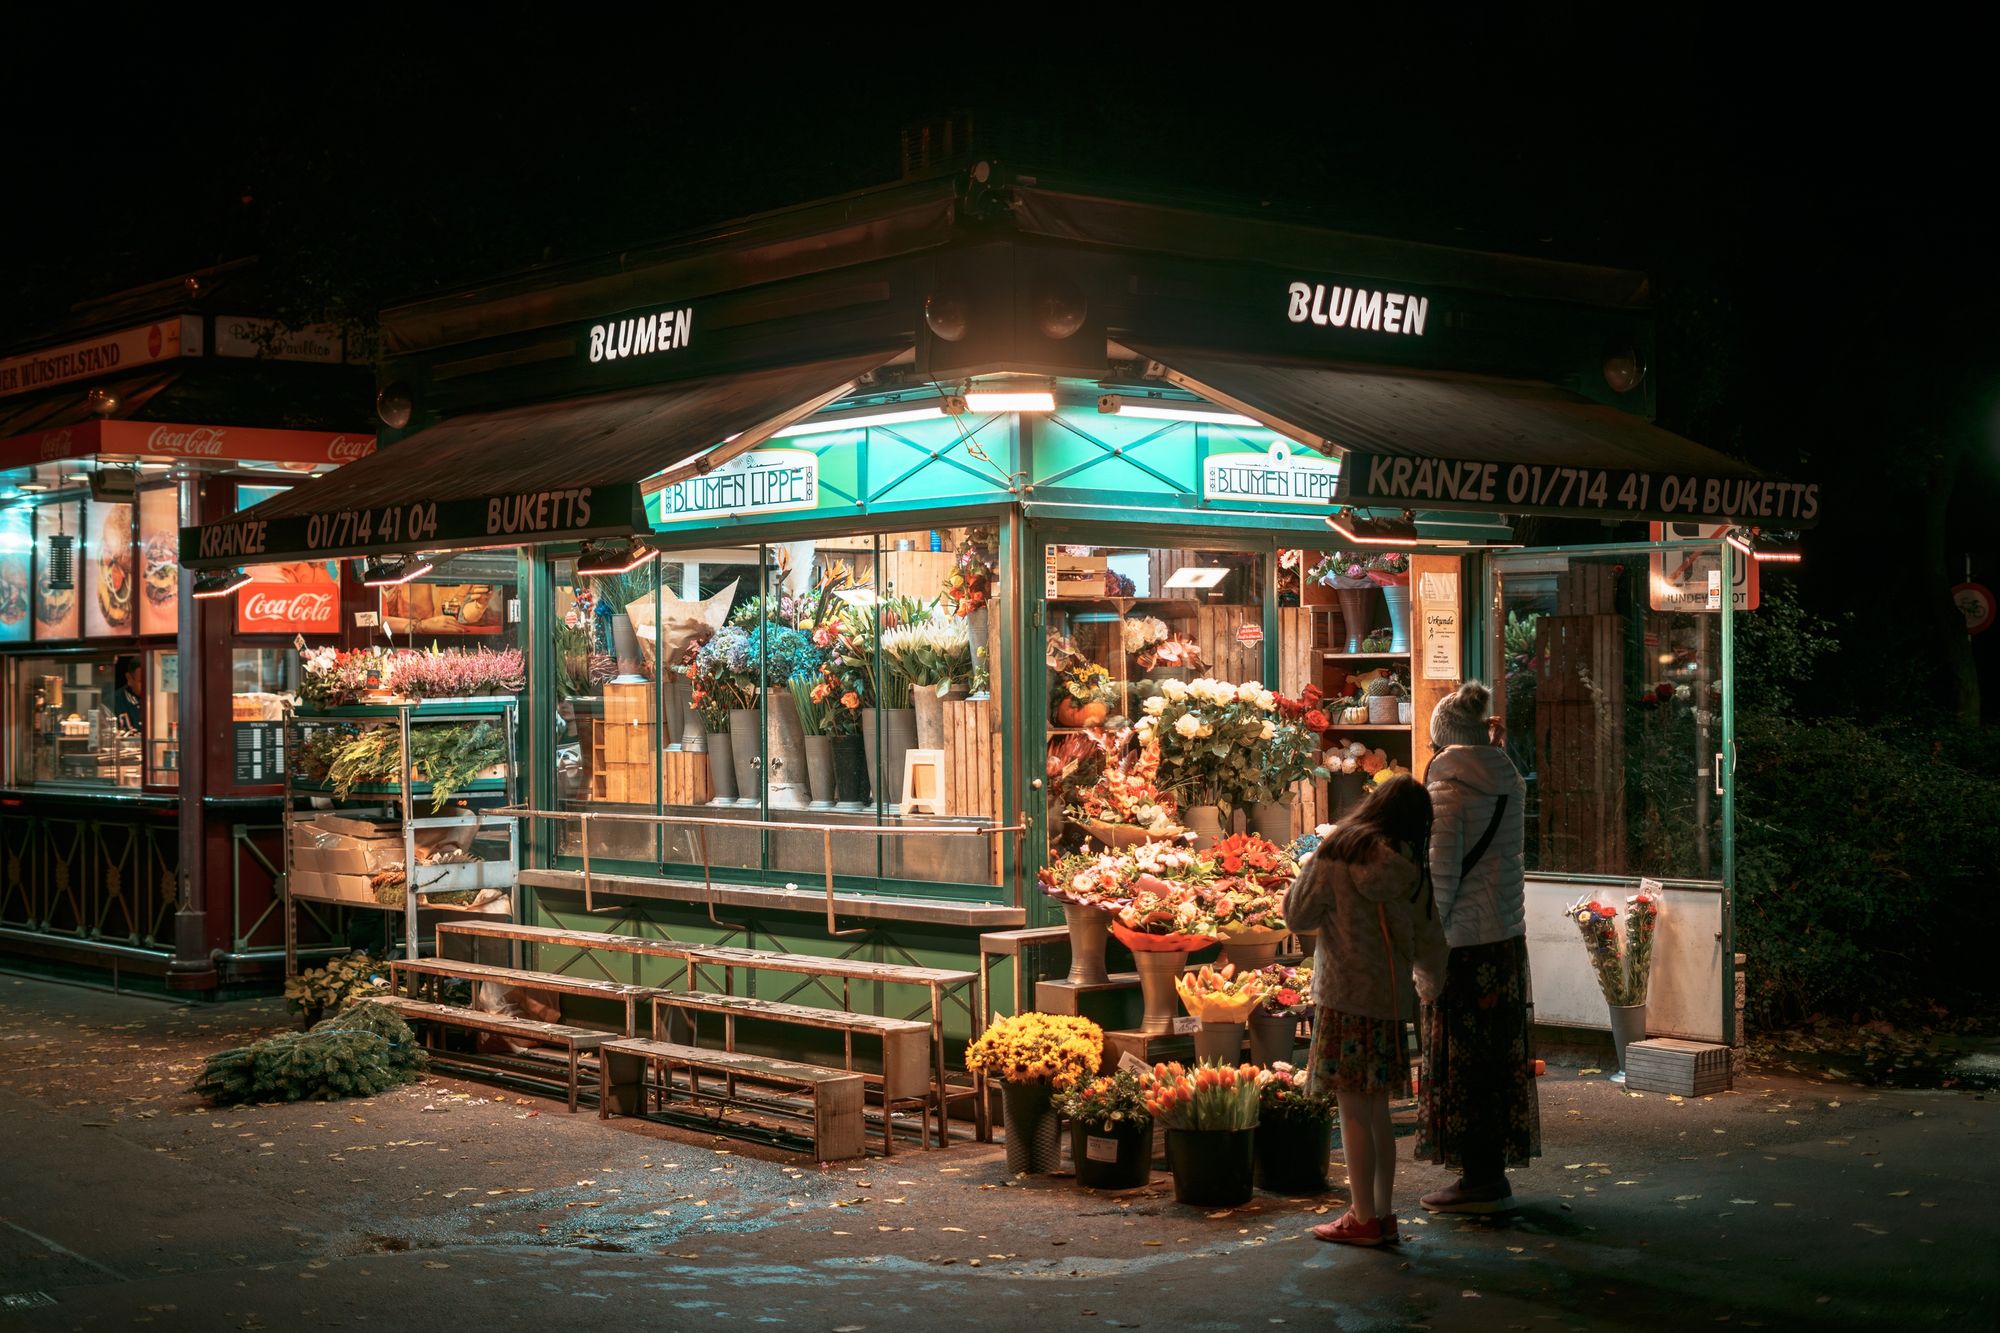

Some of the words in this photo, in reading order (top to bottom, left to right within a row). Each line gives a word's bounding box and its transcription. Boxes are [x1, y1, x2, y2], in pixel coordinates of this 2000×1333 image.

[1287, 281, 1429, 336] BLUMEN
[589, 307, 693, 363] BLUMEN
[20, 342, 121, 387] WÜRSTELSTAND
[147, 425, 226, 456] Coca-Cola
[674, 474, 745, 514] BLUMEN
[751, 467, 804, 506] LIPPE
[1218, 467, 1289, 496] BLUMEN
[1367, 455, 1499, 502] KRÄNZE
[1507, 464, 1609, 507] 01/714
[1617, 472, 1650, 511] 41
[1660, 475, 1698, 513] 04
[1702, 478, 1819, 520] BUKETTS
[199, 520, 268, 558] KRÄNZE
[307, 509, 372, 549] 01/714
[378, 507, 401, 542] 41
[408, 502, 437, 540] 04
[487, 487, 592, 535] BUKETTS
[244, 592, 335, 623] Coca-Cola
[1427, 616, 1454, 626] Urkunde
